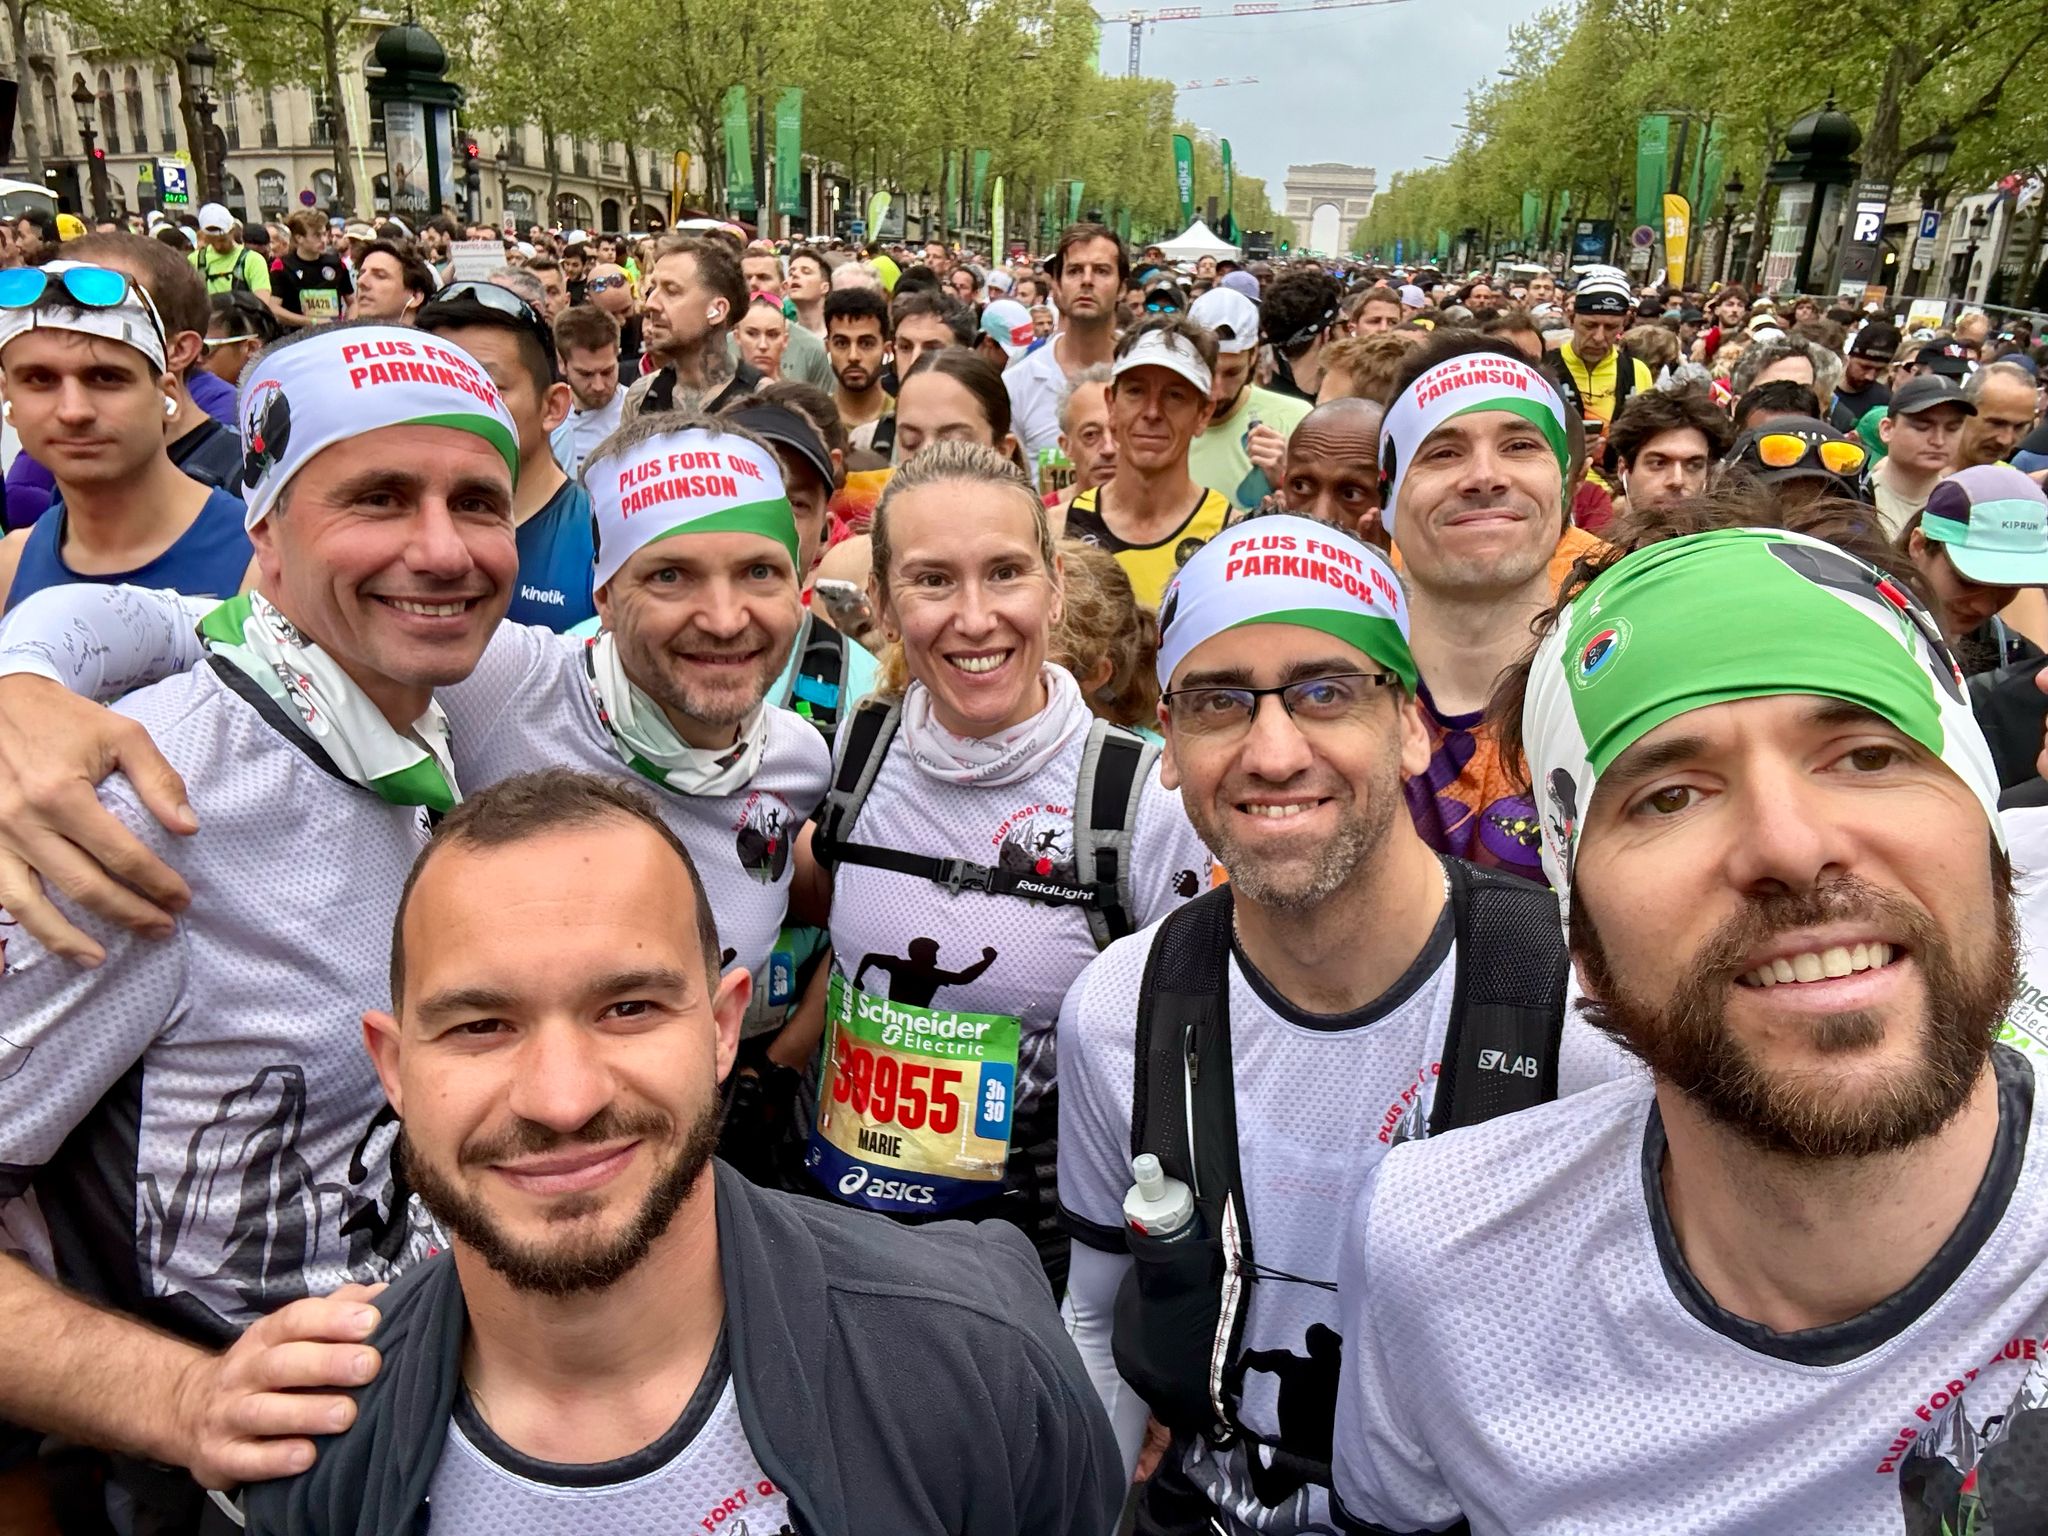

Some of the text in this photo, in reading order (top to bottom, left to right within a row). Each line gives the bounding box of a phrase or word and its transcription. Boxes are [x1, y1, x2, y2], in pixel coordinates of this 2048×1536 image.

[163, 167, 179, 188] P
[1853, 213, 1880, 241] P
[1924, 216, 1935, 234] P
[342, 341, 479, 381] PLUS FORT
[1415, 362, 1462, 395] PLUS
[1469, 358, 1518, 370] FORT
[1416, 370, 1528, 411] PARKINSON
[619, 452, 764, 493] PLUS FORT QUE
[621, 475, 738, 520] PARKINSON
[2002, 521, 2039, 530] KIPRUN
[1228, 535, 1297, 557] PLUS
[1306, 539, 1363, 575] FORT
[1225, 555, 1374, 606] PARKINSON
[991, 804, 1069, 846] PLUS FORT QUE
[1016, 879, 1095, 901] RaidLight
[857, 993, 992, 1040] Schneider
[904, 1032, 985, 1057] Electric
[985, 1078, 1006, 1101] 3h
[983, 1101, 1006, 1123] 30
[1378, 1103, 1404, 1144] PLUS
[857, 1127, 903, 1159] MARIE
[865, 1176, 936, 1205] asics
[1876, 1427, 1918, 1474] PLUS
[701, 1488, 748, 1533] FORT
